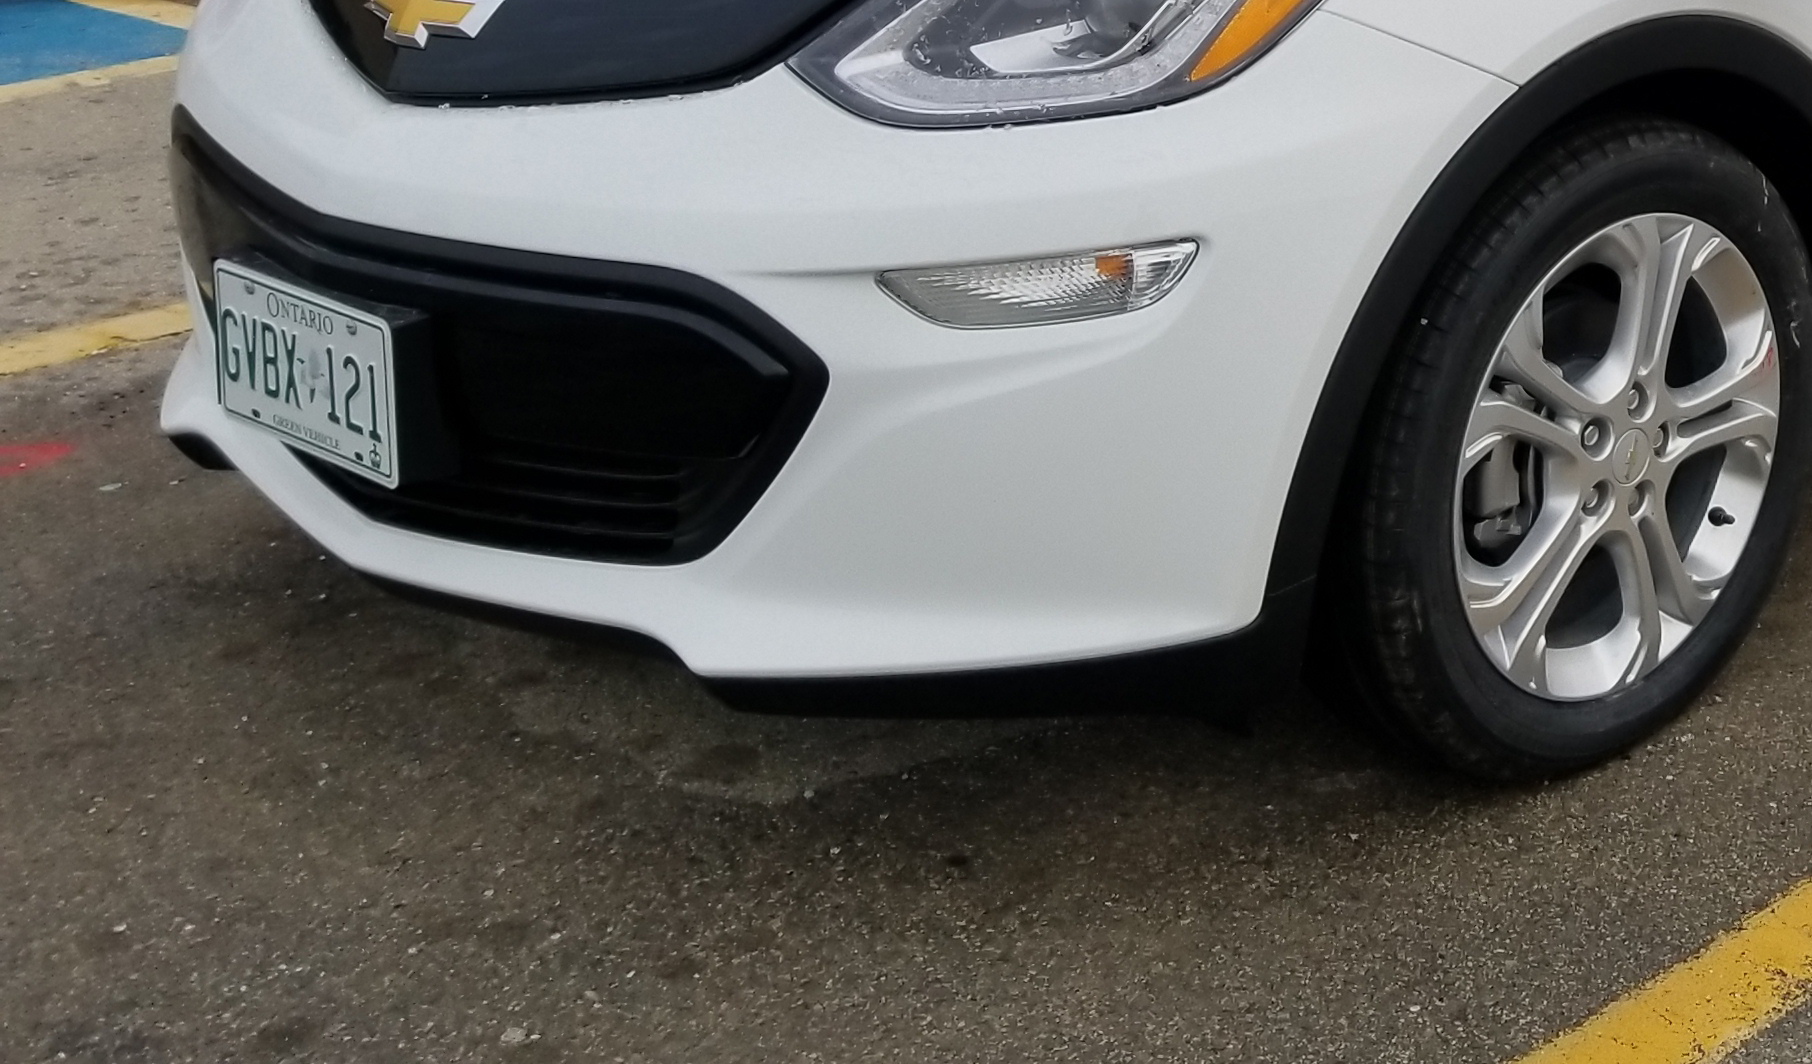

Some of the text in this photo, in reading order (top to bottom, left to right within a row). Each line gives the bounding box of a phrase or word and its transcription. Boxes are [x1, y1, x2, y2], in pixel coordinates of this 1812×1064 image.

[266, 292, 334, 336] ONTARIO
[221, 308, 382, 444] GVBX 121
[303, 426, 341, 450] VEHICLE
